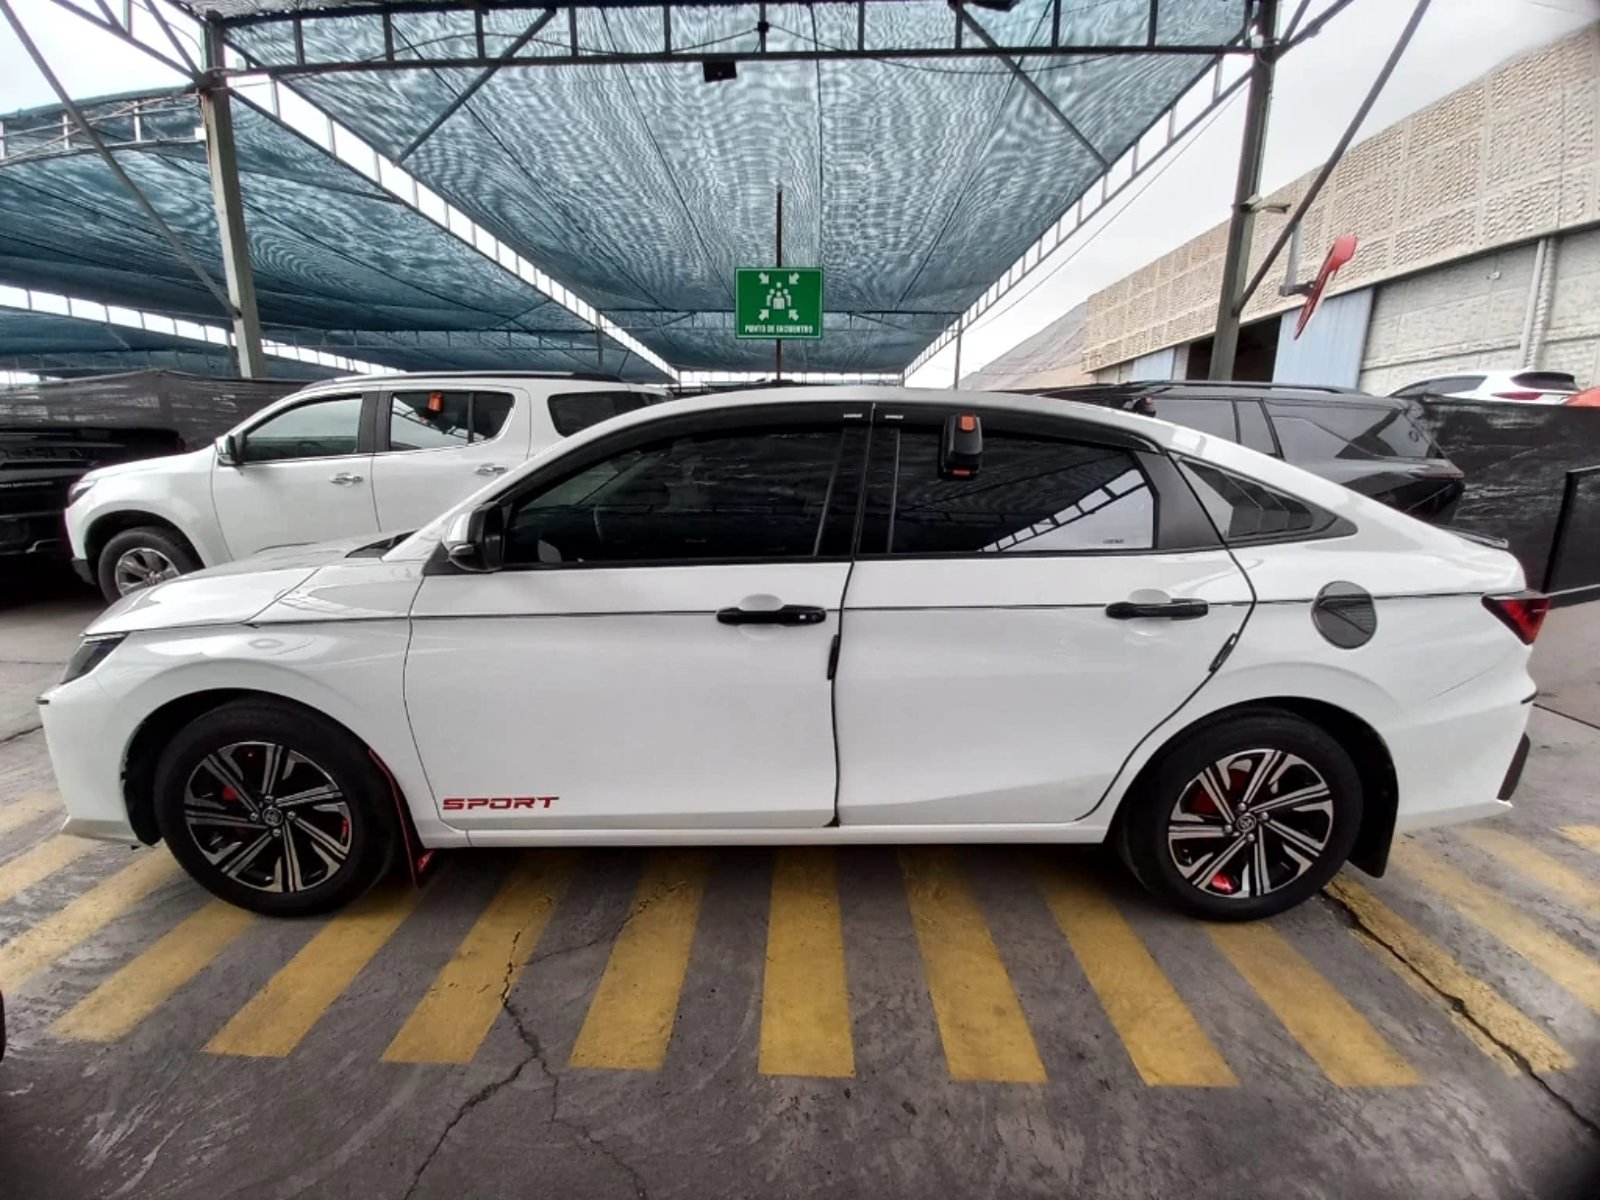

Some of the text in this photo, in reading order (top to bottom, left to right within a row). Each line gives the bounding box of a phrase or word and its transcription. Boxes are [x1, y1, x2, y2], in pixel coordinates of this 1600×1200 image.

[744, 324, 813, 334] PUNTO DE ENCUENTRO
[443, 796, 560, 810] SPORT
